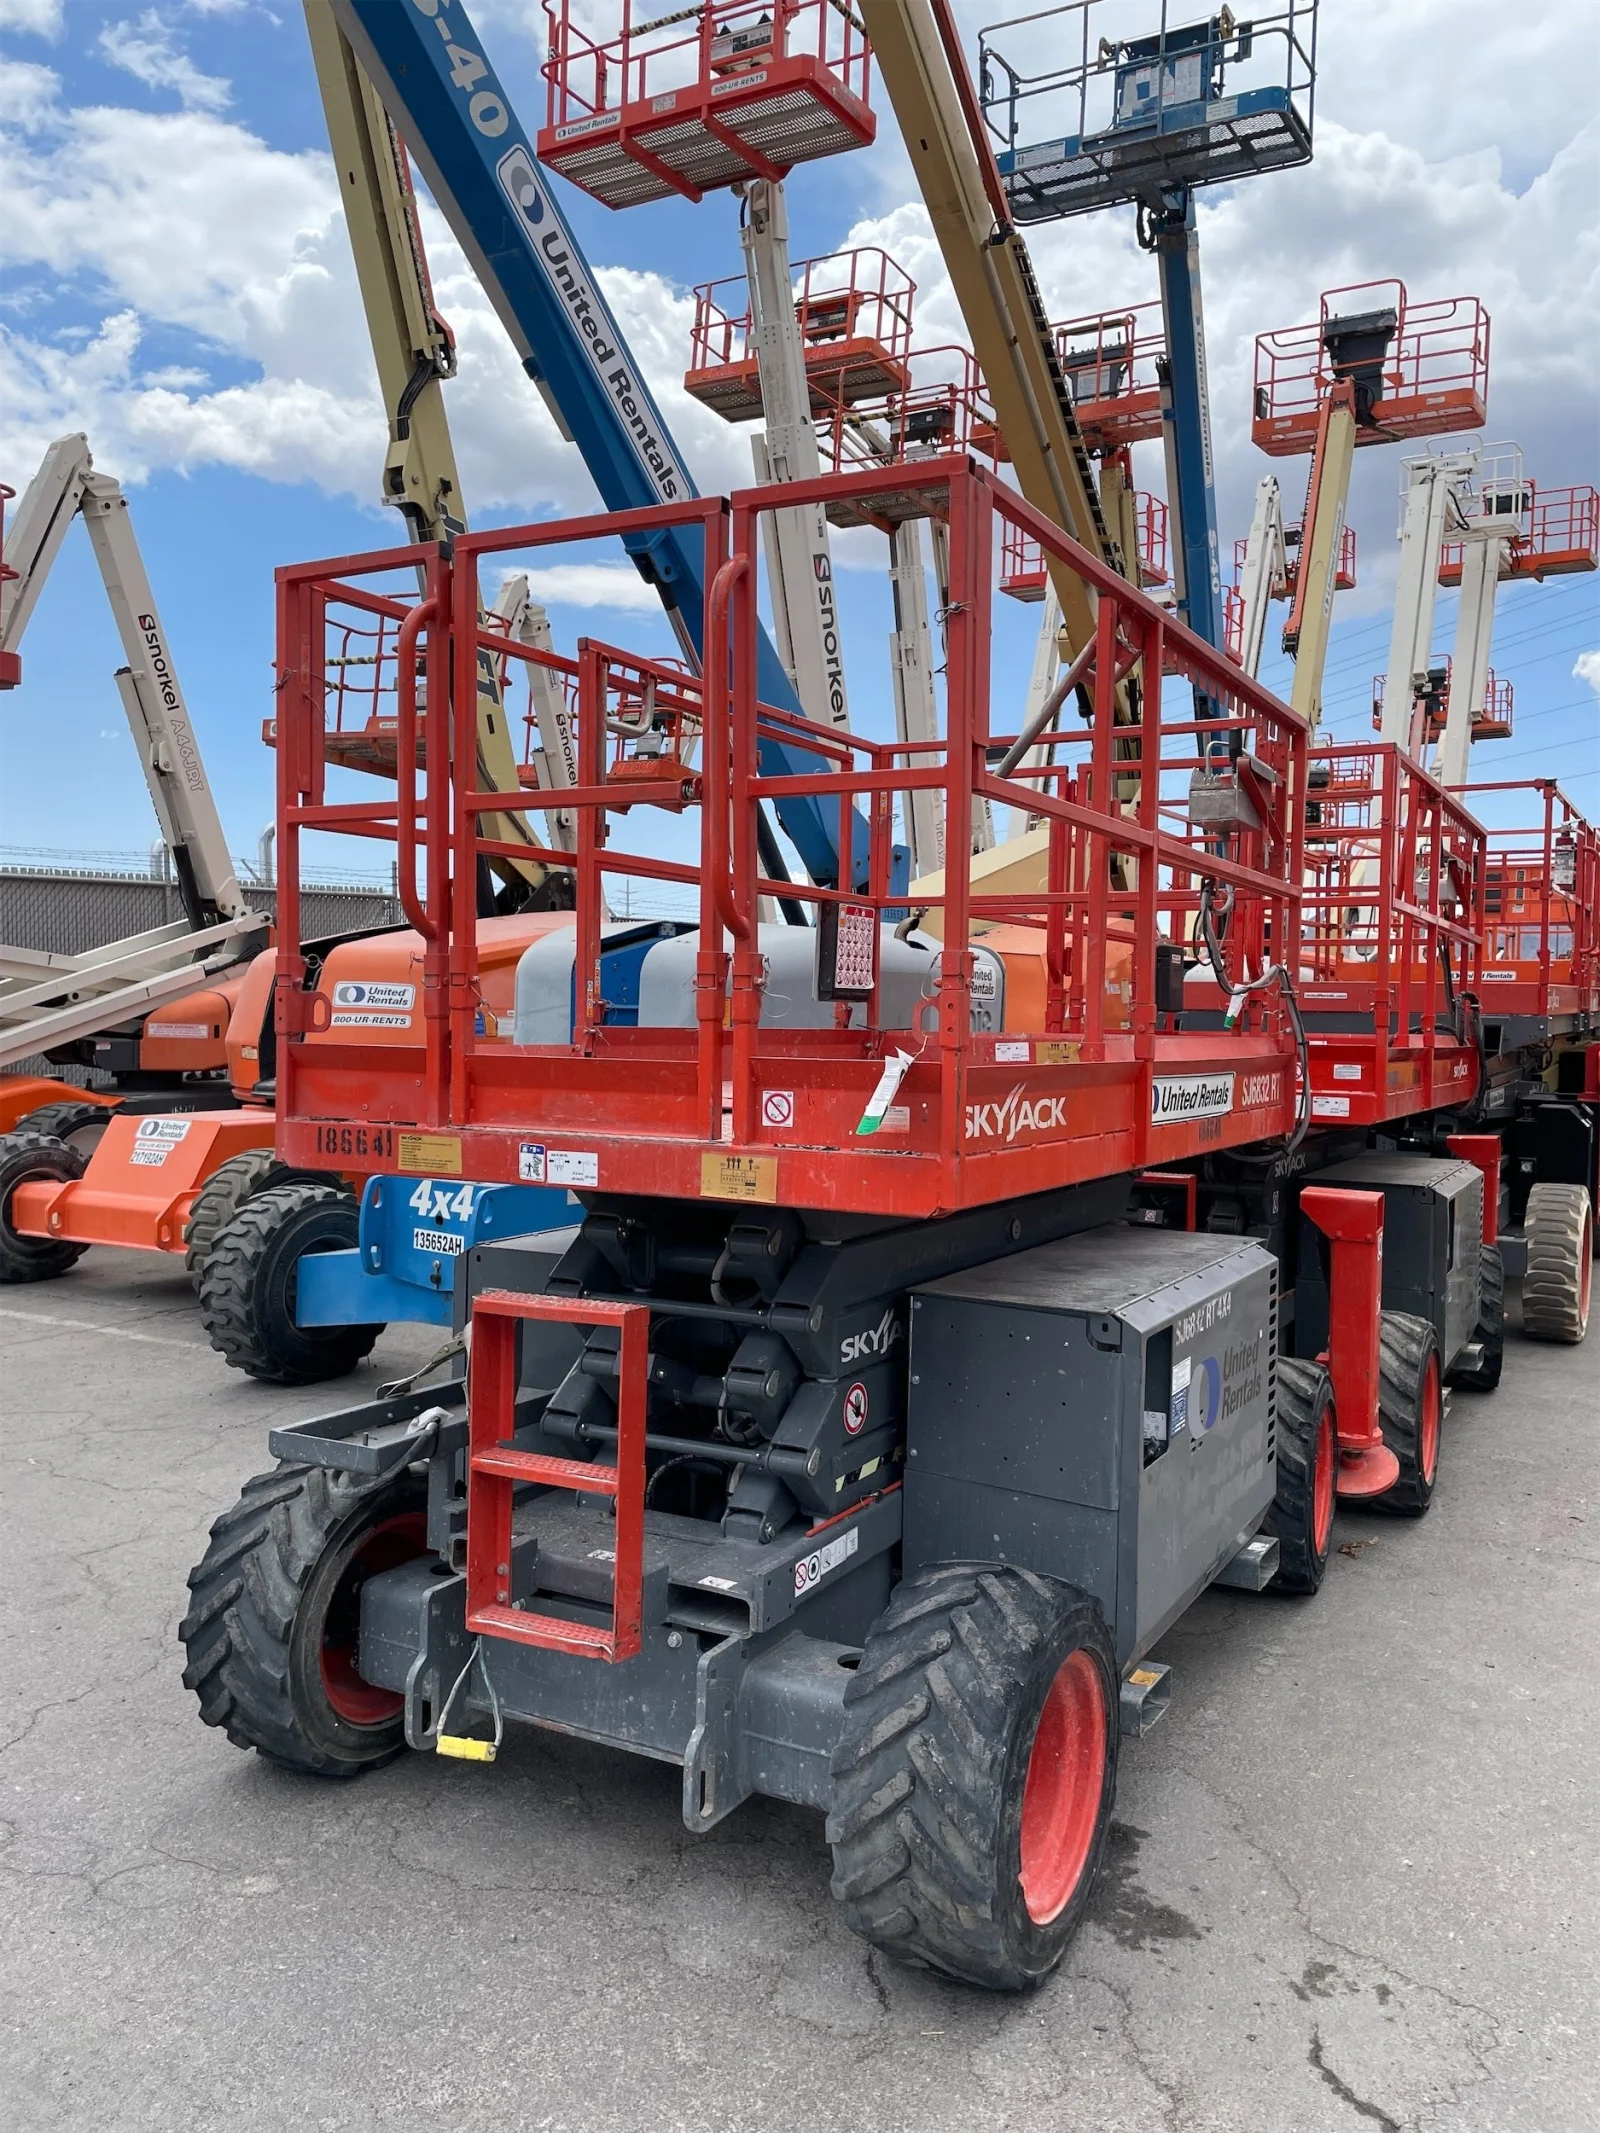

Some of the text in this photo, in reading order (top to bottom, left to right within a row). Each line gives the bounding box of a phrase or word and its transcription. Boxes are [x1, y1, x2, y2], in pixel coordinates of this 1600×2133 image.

[713, 73, 765, 94] 800-UR-RENTS
[567, 112, 618, 135] United Rentals
[541, 230, 679, 499] United Rentals
[1208, 528, 1221, 594] S-40
[818, 585, 847, 724] snorkel
[145, 632, 180, 711] snorkel
[170, 719, 205, 791] A46JRT
[558, 725, 579, 786] snorkel
[367, 995, 409, 1006] Rentals
[368, 986, 407, 997] United
[969, 981, 995, 995] Rentals
[333, 1016, 407, 1025] 800-UR-RENTS
[1161, 1081, 1230, 1112] United Rentals
[1241, 1073, 1281, 1106] SJ6832 RT
[161, 1121, 187, 1131] United
[965, 1082, 1067, 1142] SKYJACK
[156, 1130, 184, 1139] Rentals
[317, 1127, 392, 1157] 186641
[1274, 1153, 1306, 1178] SKYJACK
[415, 1230, 463, 1256] 135652AH
[1205, 1298, 1217, 1329] RT
[1222, 1335, 1260, 1382] United
[1221, 1372, 1262, 1420] Rentals
